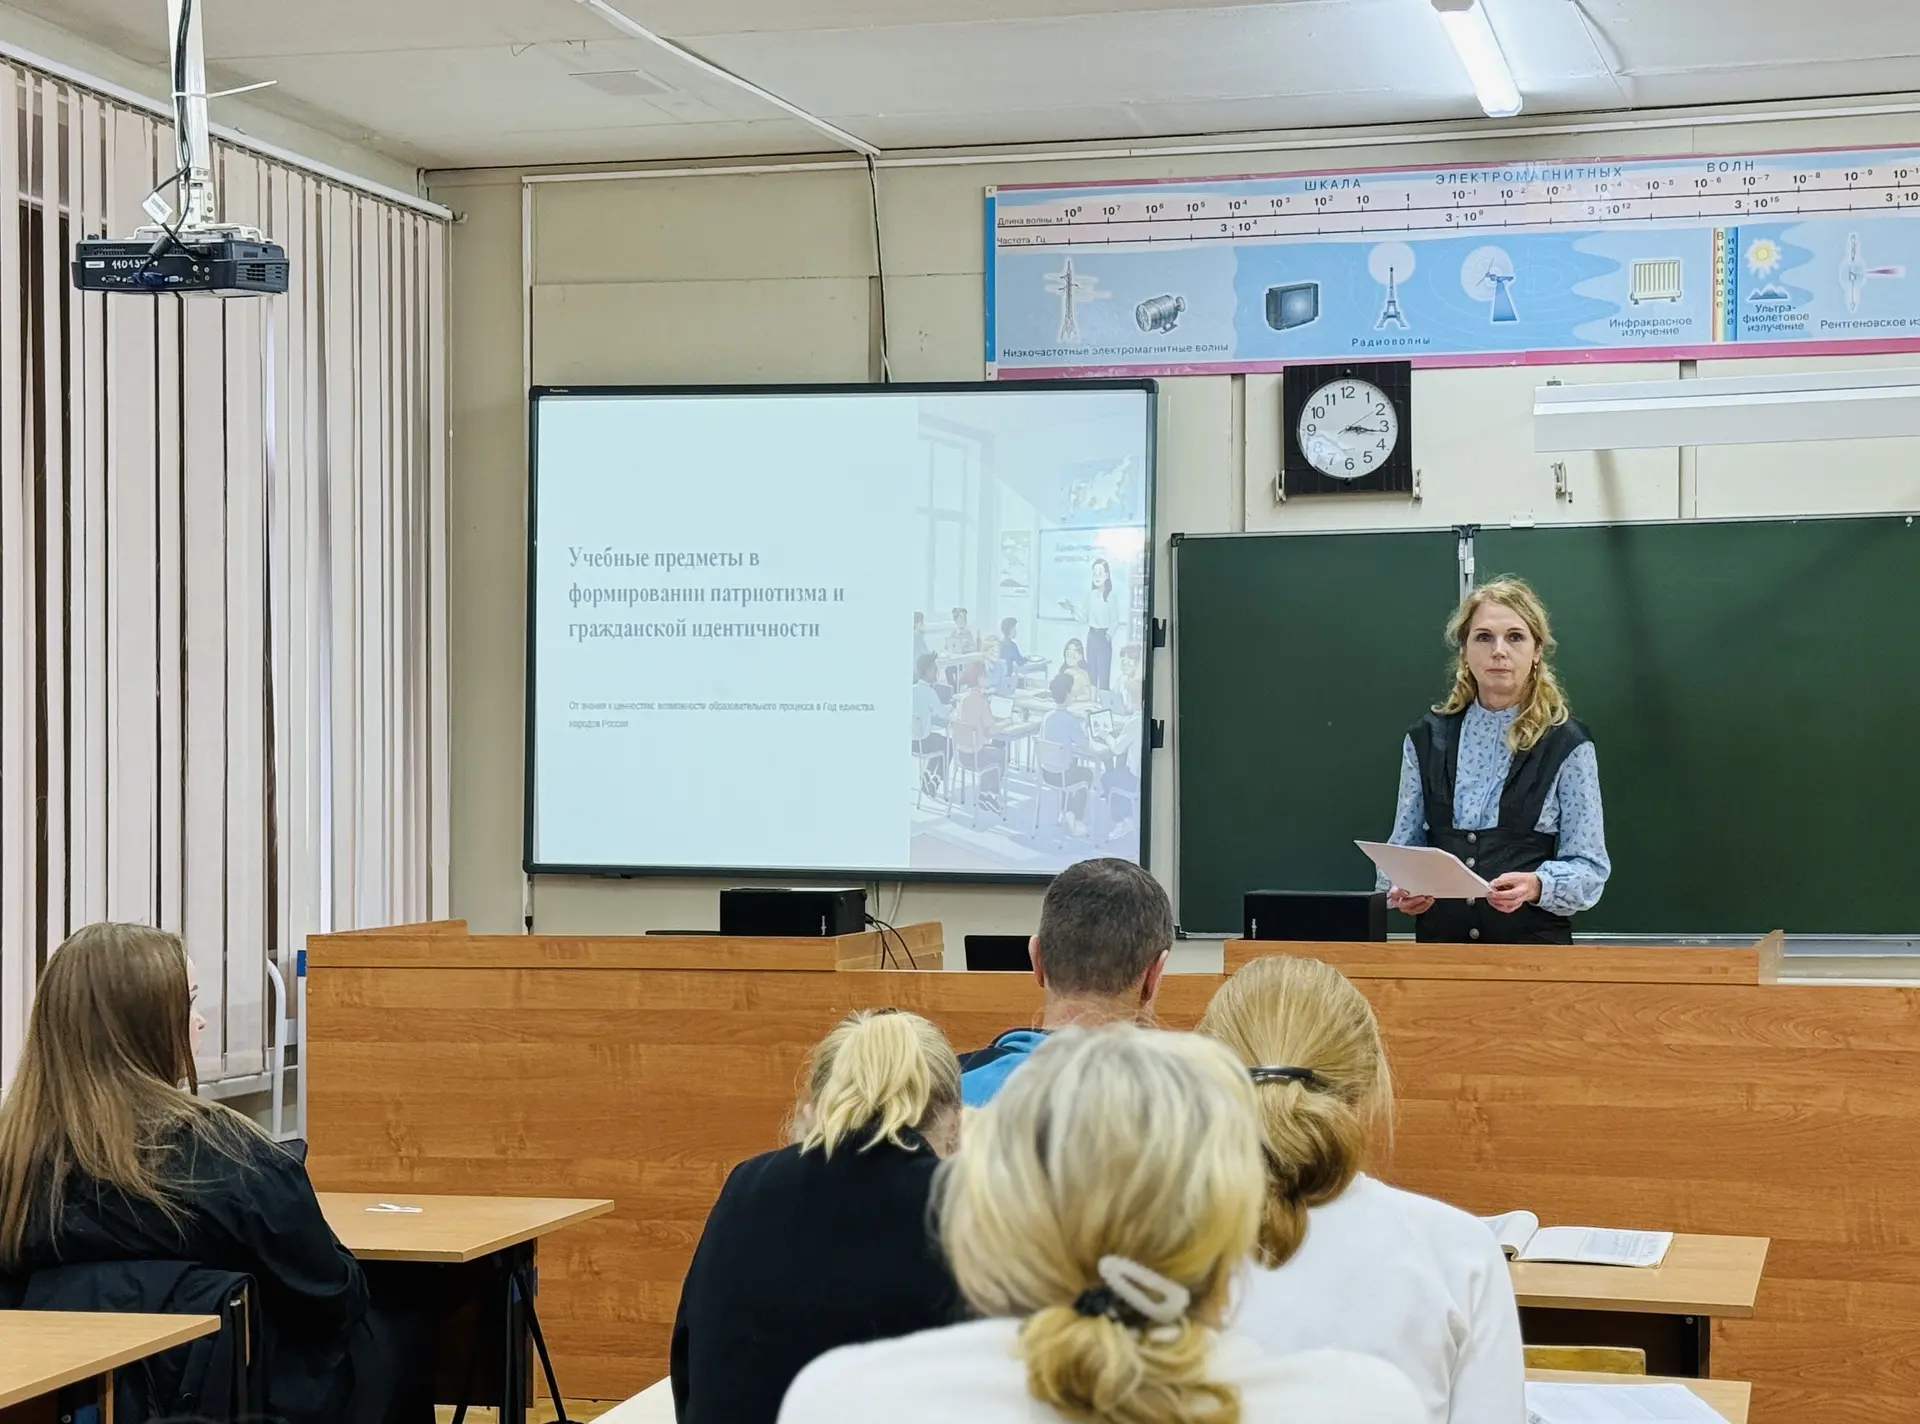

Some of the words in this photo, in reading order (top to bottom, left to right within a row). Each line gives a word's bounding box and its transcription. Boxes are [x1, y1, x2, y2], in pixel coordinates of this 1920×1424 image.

[1304, 178, 1361, 191] ШКАЛА
[1436, 166, 1622, 185] ЭЛЕКТРОМАГНИТНЫХ
[1706, 160, 1755, 173] ВОЛН
[998, 217, 1024, 226] Длина
[1356, 195, 1370, 204] 10
[1405, 193, 1411, 202] 1
[1036, 236, 1046, 244] Гц
[1716, 231, 1724, 309] Видимое
[1727, 237, 1735, 326] излучение
[1754, 304, 1797, 317] Ультра-
[1609, 317, 1693, 331] Инфракрасное
[1742, 312, 1810, 326] фиолетовое
[1820, 319, 1906, 329] Рентгеновское
[1620, 326, 1680, 338] излучение
[1747, 322, 1805, 334] излучение
[1351, 336, 1432, 348] Радиоволны
[1003, 348, 1090, 359] Низкочастотные
[1091, 344, 1193, 357] электромагнитные
[1195, 343, 1229, 353] волны
[1341, 386, 1356, 399] 12
[1365, 391, 1370, 404] 1
[1324, 394, 1336, 406] 11
[1311, 406, 1325, 419] 10
[1375, 403, 1386, 416] 2
[1307, 424, 1316, 436] 9
[1380, 420, 1389, 433] 3
[1313, 441, 1323, 453] 8
[1376, 438, 1386, 450] 4
[1328, 453, 1337, 466] 7
[1363, 451, 1373, 463] 5
[1345, 458, 1355, 470] 6
[568, 546, 649, 567] Учебные
[654, 551, 743, 572] предметы
[749, 552, 760, 566] в
[568, 582, 705, 608] формировании
[710, 587, 828, 608] патриотизма
[833, 587, 844, 602] и
[568, 618, 687, 643] гражданской
[692, 621, 820, 639] идентичности
[708, 701, 777, 711] образовательного
[779, 702, 814, 712] процесса
[823, 702, 837, 712] Год
[839, 702, 874, 711] единства
